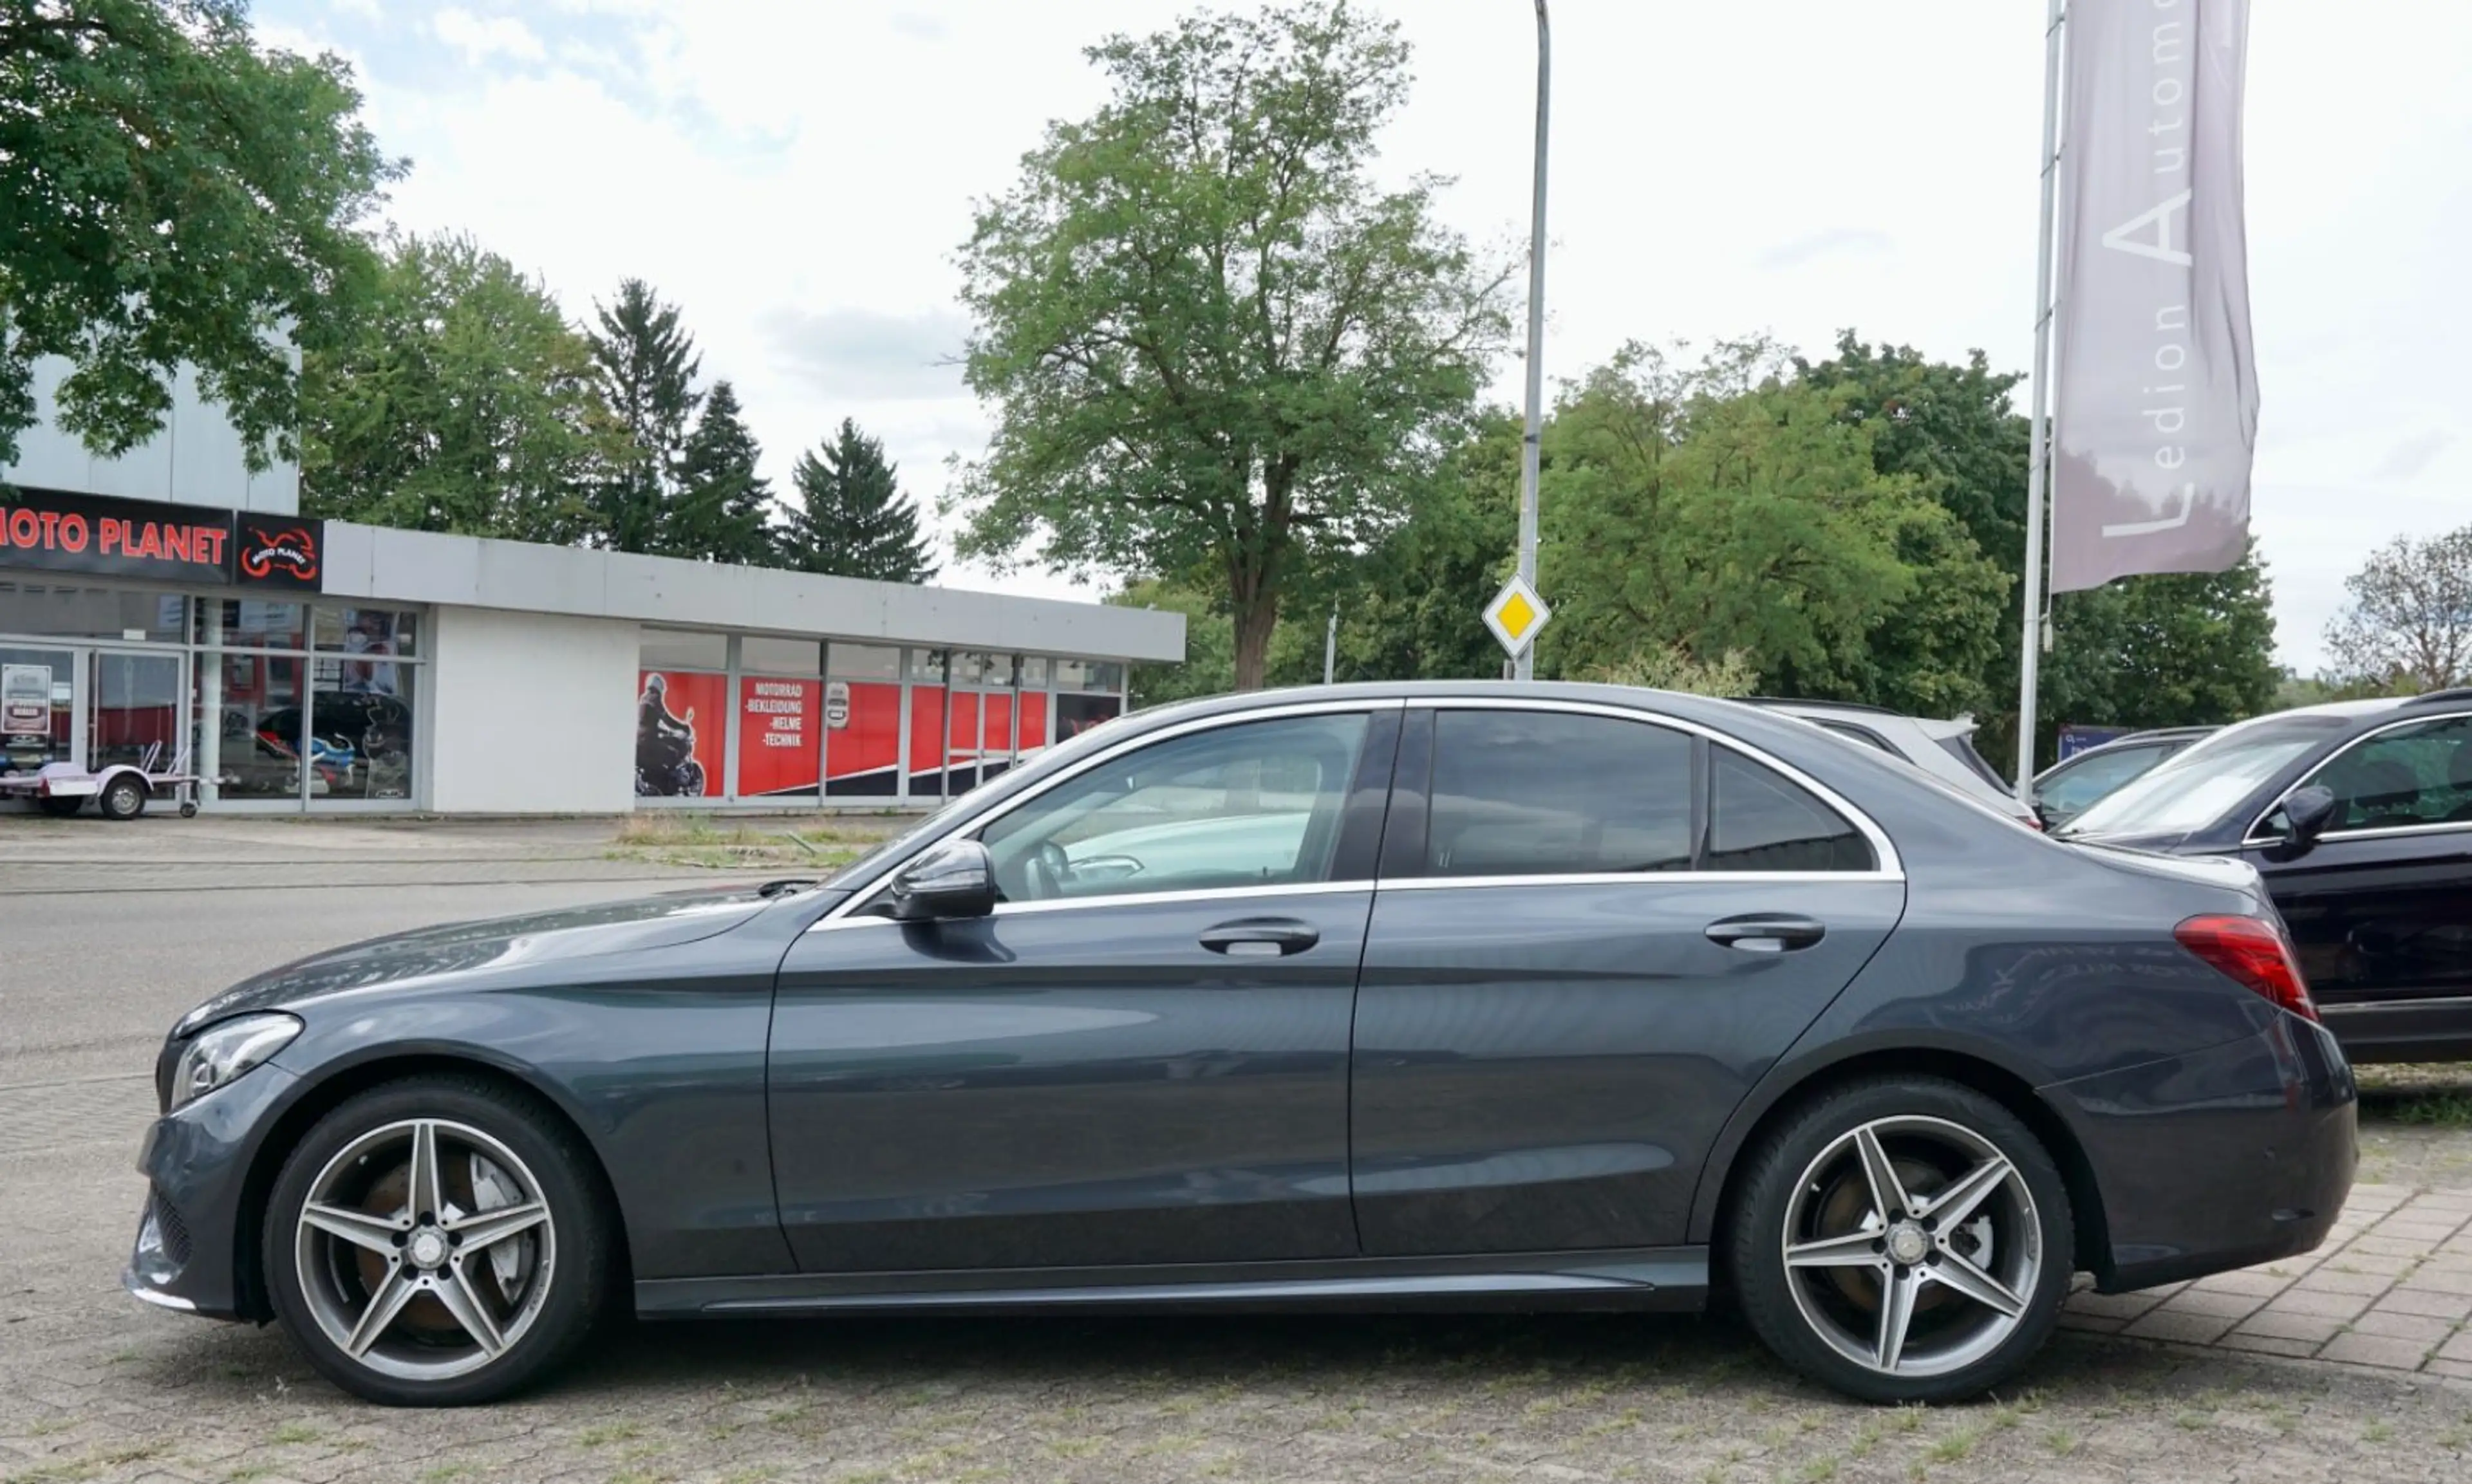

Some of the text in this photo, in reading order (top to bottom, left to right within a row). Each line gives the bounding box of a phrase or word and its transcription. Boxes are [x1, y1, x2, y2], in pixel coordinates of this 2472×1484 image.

[2102, 304, 2195, 538] Ledion
[100, 517, 227, 564] PLANET
[755, 682, 802, 697] MOTORRAD
[745, 698, 802, 714] -BEKLEIDUNG
[762, 732, 803, 747] -TECHNIK
